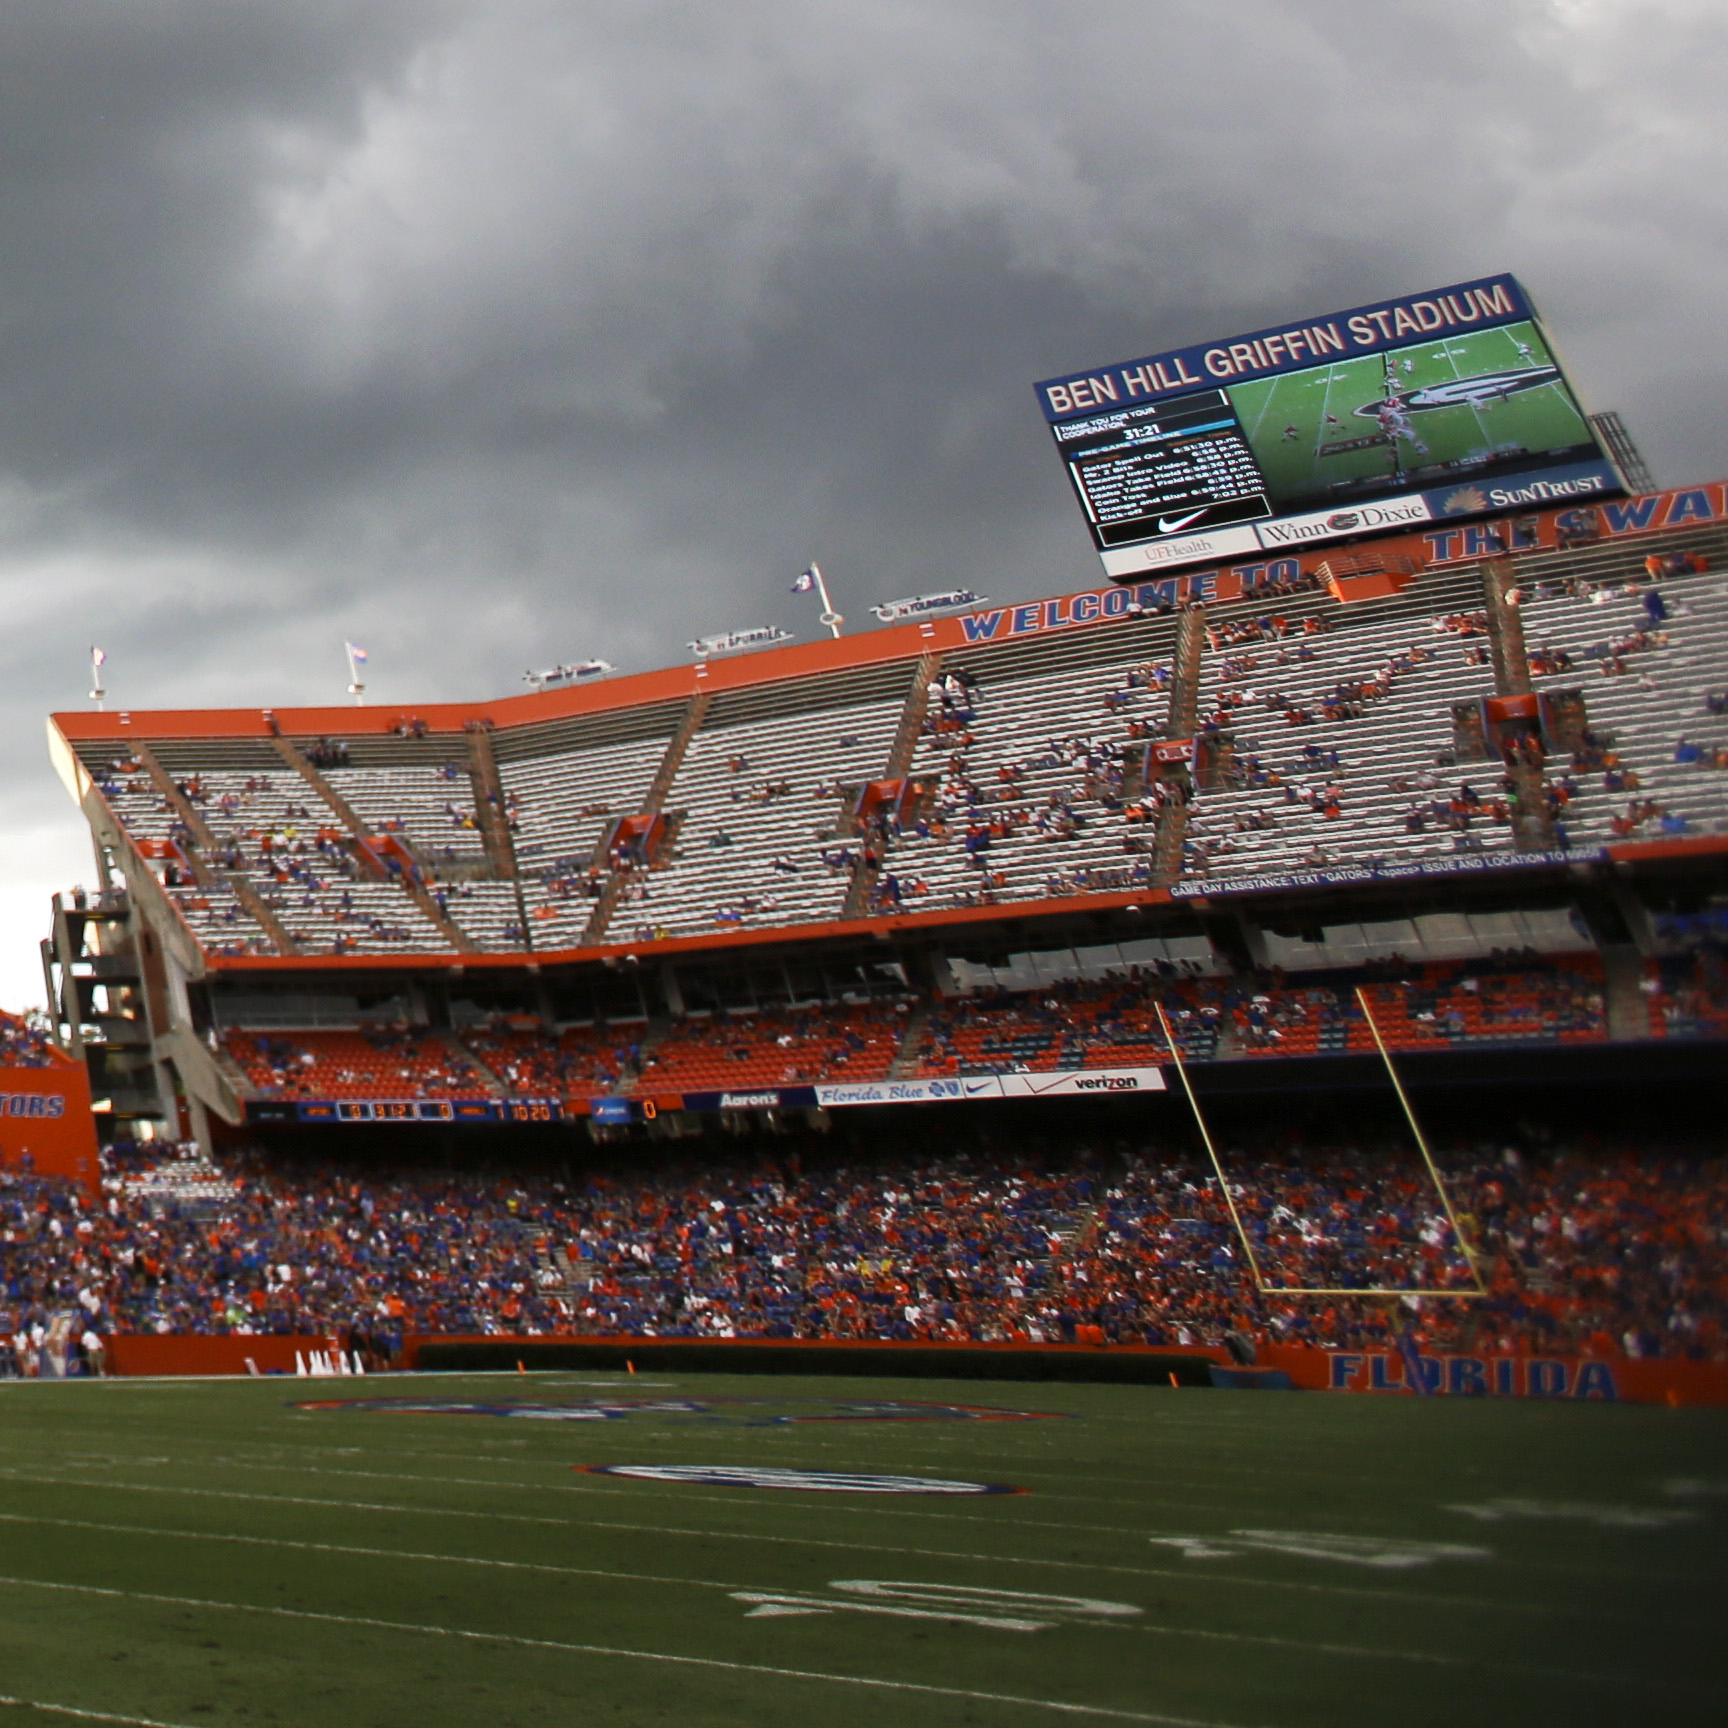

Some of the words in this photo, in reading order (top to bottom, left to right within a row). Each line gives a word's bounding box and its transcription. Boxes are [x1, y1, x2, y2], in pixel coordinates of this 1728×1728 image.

[1046, 373, 1118, 414] BEN
[1121, 357, 1204, 398] HILL
[1204, 322, 1346, 378] GRIFFIN
[1347, 284, 1516, 347] STADIUM
[1060, 422, 1088, 432] THANK
[1090, 416, 1110, 426] YOU
[1110, 412, 1130, 422] FOR
[1129, 407, 1156, 417] YOUR
[1123, 424, 1160, 440] 31:21
[1143, 452, 1165, 460] Out
[1215, 437, 1241, 446] p.m.
[1218, 443, 1244, 452] p.m.
[1086, 474, 1125, 486] Swamp
[1155, 461, 1188, 471] Video
[1223, 450, 1248, 459] p.m.
[1087, 482, 1123, 493] Gators
[1153, 469, 1182, 479] Field
[1227, 456, 1253, 466] p.m.
[1090, 490, 1121, 500] Idaho
[1123, 483, 1155, 493] Takes
[1156, 476, 1185, 487] Field
[1229, 464, 1255, 473] p.m.
[1094, 498, 1120, 507] Coin
[1121, 492, 1147, 501] Toss
[1235, 470, 1261, 480] p.m.
[1097, 502, 1137, 514] Orange
[1139, 497, 1161, 506] and
[1162, 492, 1188, 502] Blue
[1236, 478, 1262, 488] p.m.
[1099, 508, 1143, 521] Kick-off
[1240, 485, 1265, 495] p.m.
[1489, 475, 1606, 507] SUNTRUST
[1261, 519, 1328, 545] Winn
[1362, 502, 1424, 526] Dixie
[1423, 516, 1539, 562] THE
[1555, 481, 1728, 540] SWA
[957, 571, 1218, 642] WELCOME
[1231, 558, 1301, 601] TO
[1170, 883, 1201, 897] GAME
[1202, 881, 1223, 894] DAY
[1294, 873, 1320, 886] TEXT
[1422, 861, 1457, 873] ISSUE
[1458, 858, 1483, 870] AND
[1484, 853, 1545, 867] LOCATION
[1548, 851, 1565, 862] TO
[720, 1092, 780, 1108] Aaron's
[820, 1086, 884, 1103] Florida
[888, 1084, 924, 1100] Blue
[1075, 1074, 1139, 1090] verizon
[1327, 1352, 1618, 1400] FLORIDA
